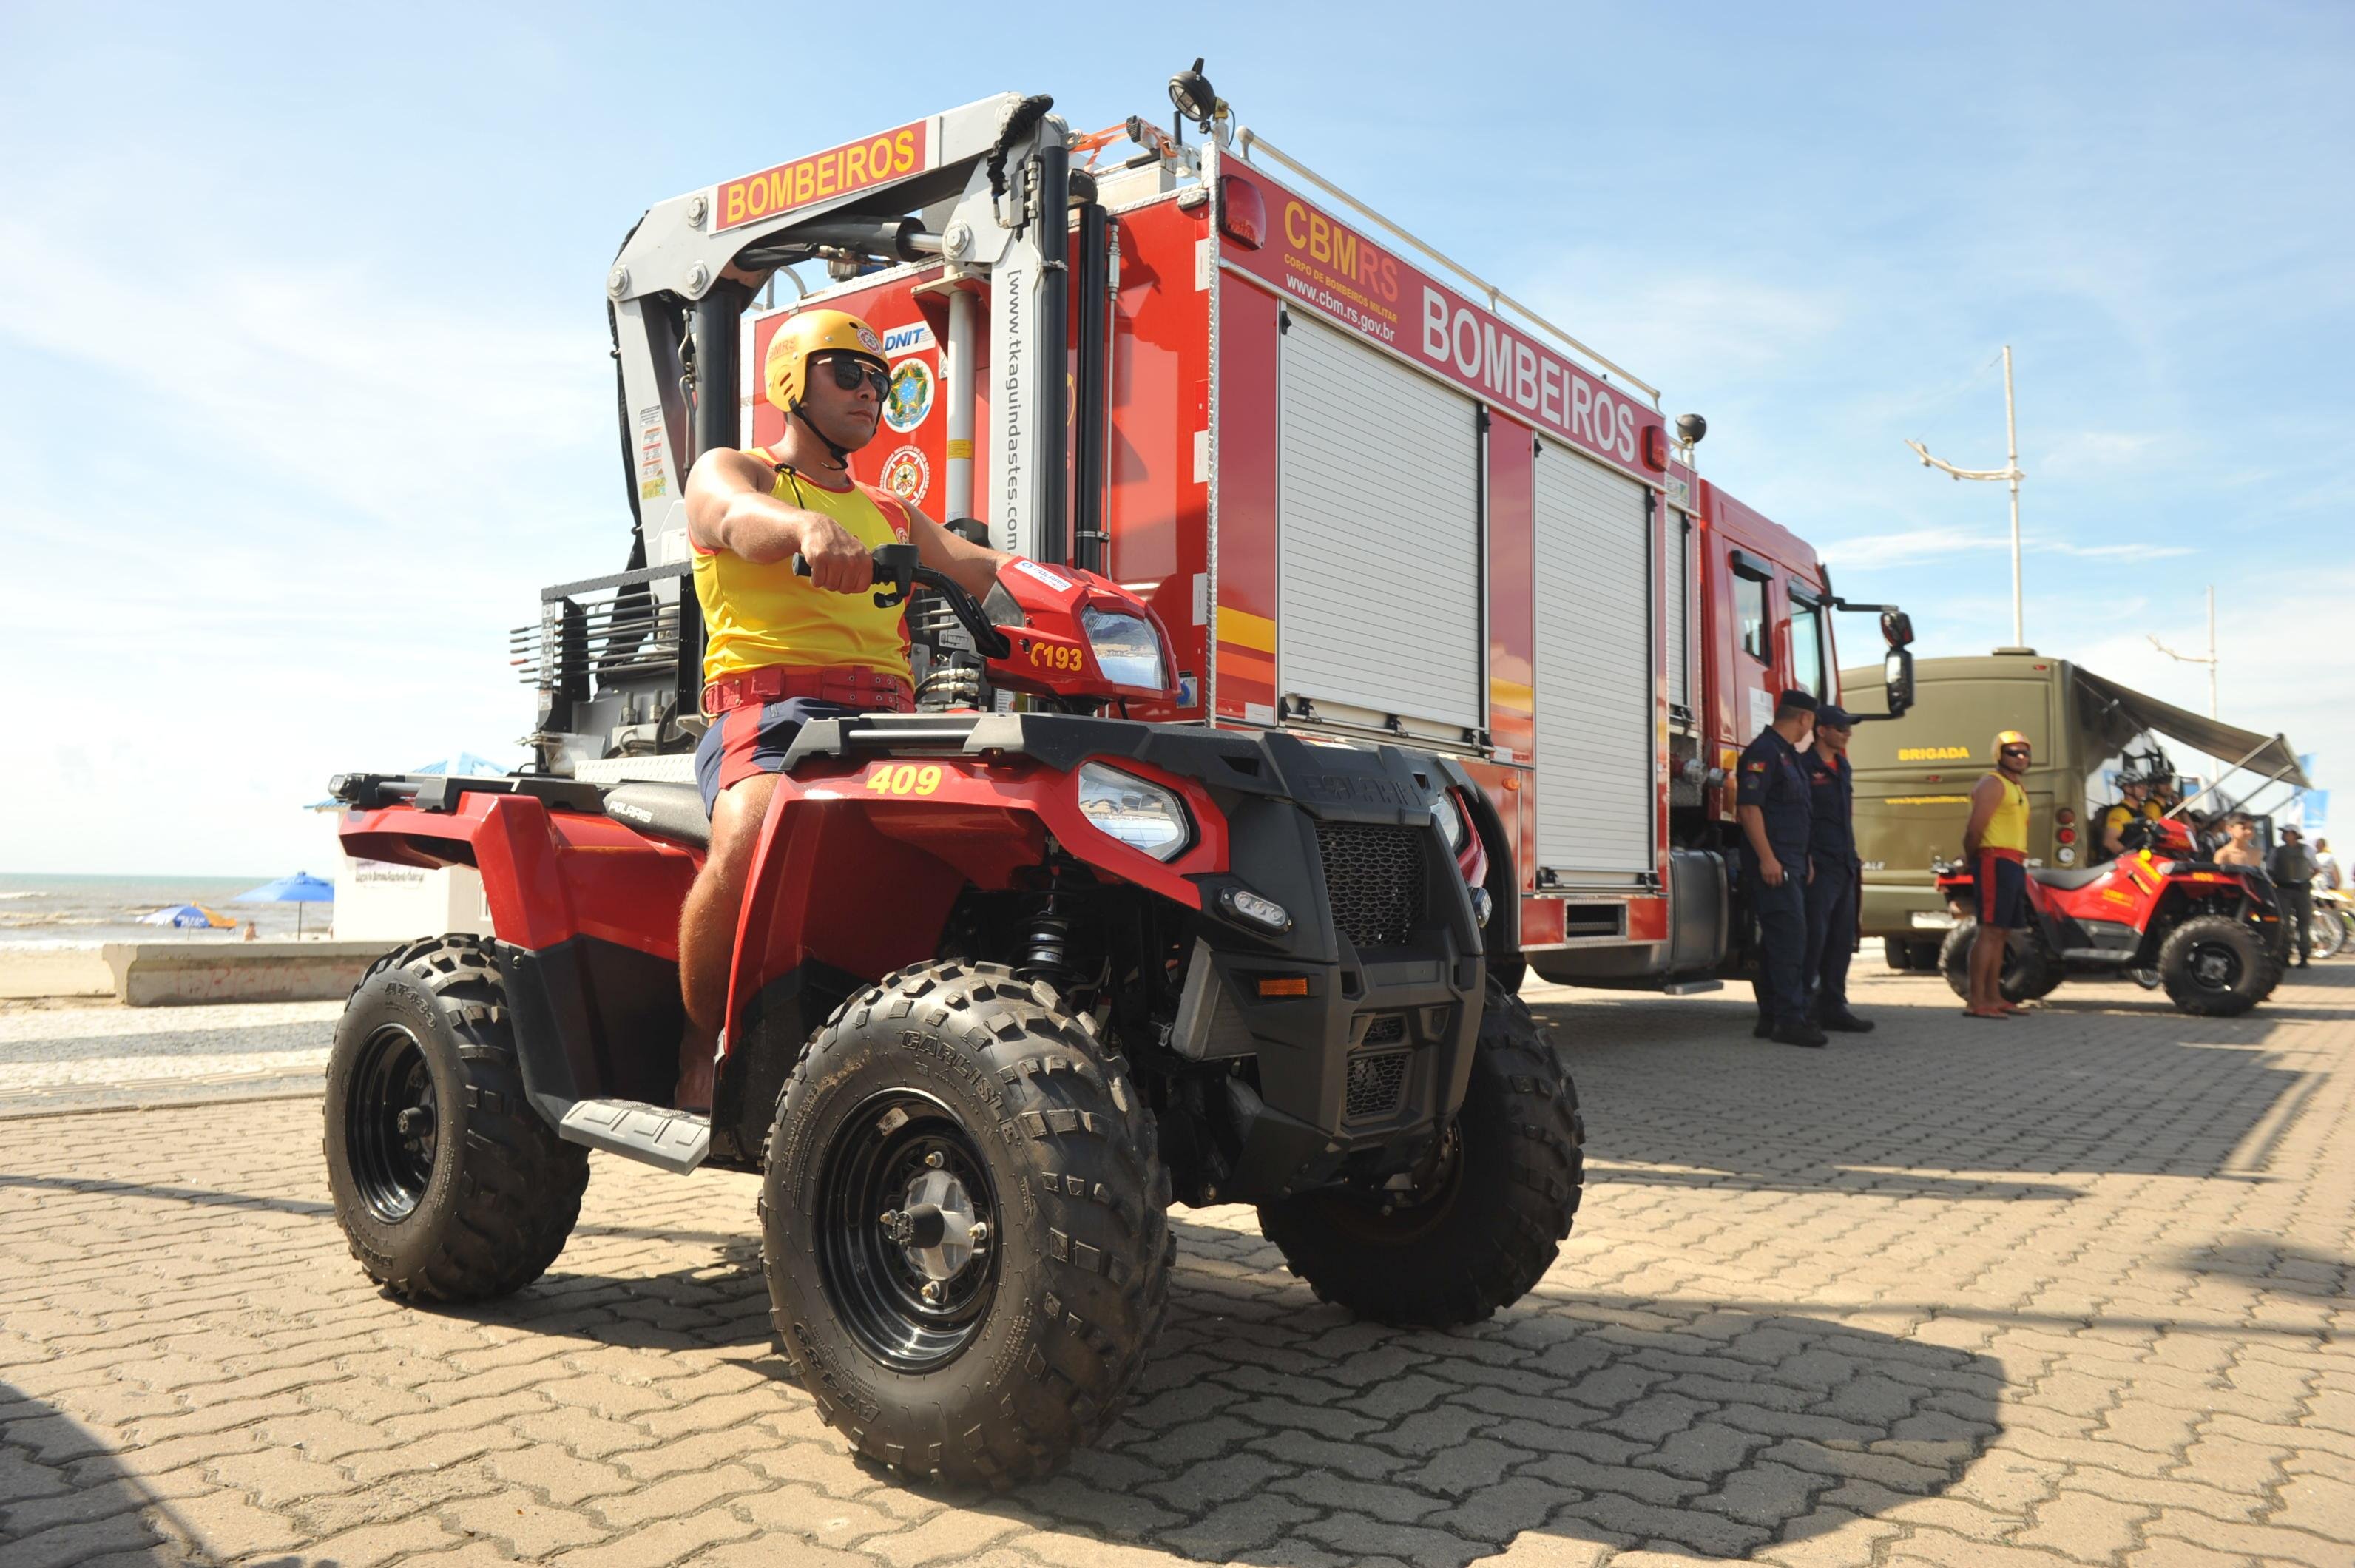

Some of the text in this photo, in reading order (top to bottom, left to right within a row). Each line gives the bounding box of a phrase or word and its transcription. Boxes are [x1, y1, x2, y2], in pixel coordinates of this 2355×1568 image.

[727, 129, 915, 223] BOMBEIROS
[1285, 200, 1399, 303] CBMRS
[1284, 254, 1398, 324] CORPO DE BOMBEIROS MILITAR
[1285, 273, 1396, 342] www.cbm.rs.gov.br
[885, 328, 925, 351] DNIT
[1423, 285, 1635, 462] BOMBEIROS
[1044, 645, 1082, 671] 193
[866, 765, 942, 795] 409
[1898, 747, 1970, 760] BRIGADA
[608, 800, 653, 823] POLARIS
[902, 1030, 1021, 1144] CARLISLE
